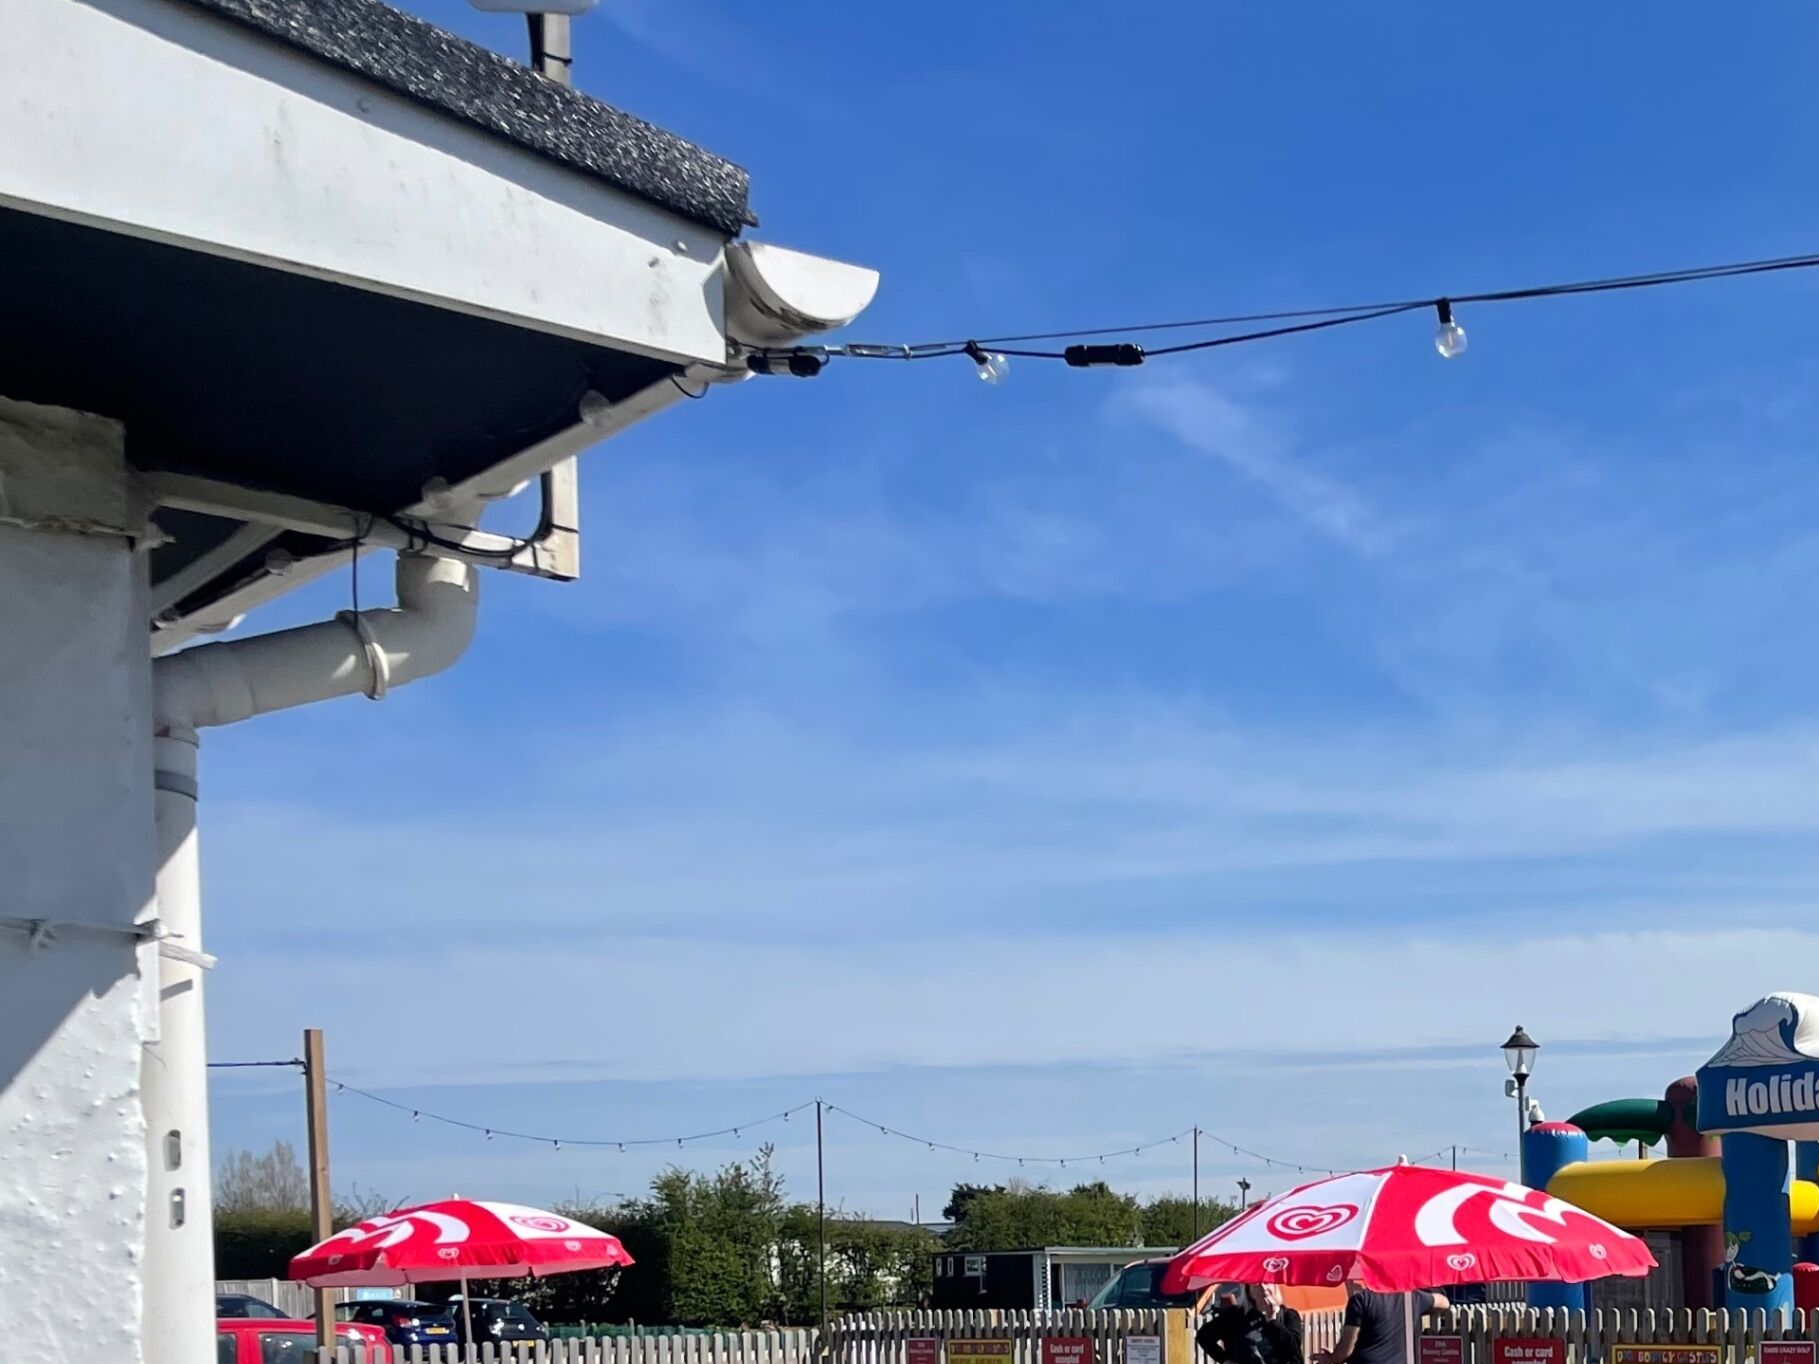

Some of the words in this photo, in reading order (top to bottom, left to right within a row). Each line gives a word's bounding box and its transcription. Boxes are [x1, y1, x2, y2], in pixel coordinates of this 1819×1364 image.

[1050, 1344, 1063, 1354] Cash
[1064, 1346, 1070, 1354] or
[1071, 1344, 1084, 1354] card
[1504, 1346, 1522, 1357] Cash
[1525, 1348, 1533, 1357] or
[1535, 1346, 1553, 1357] card
